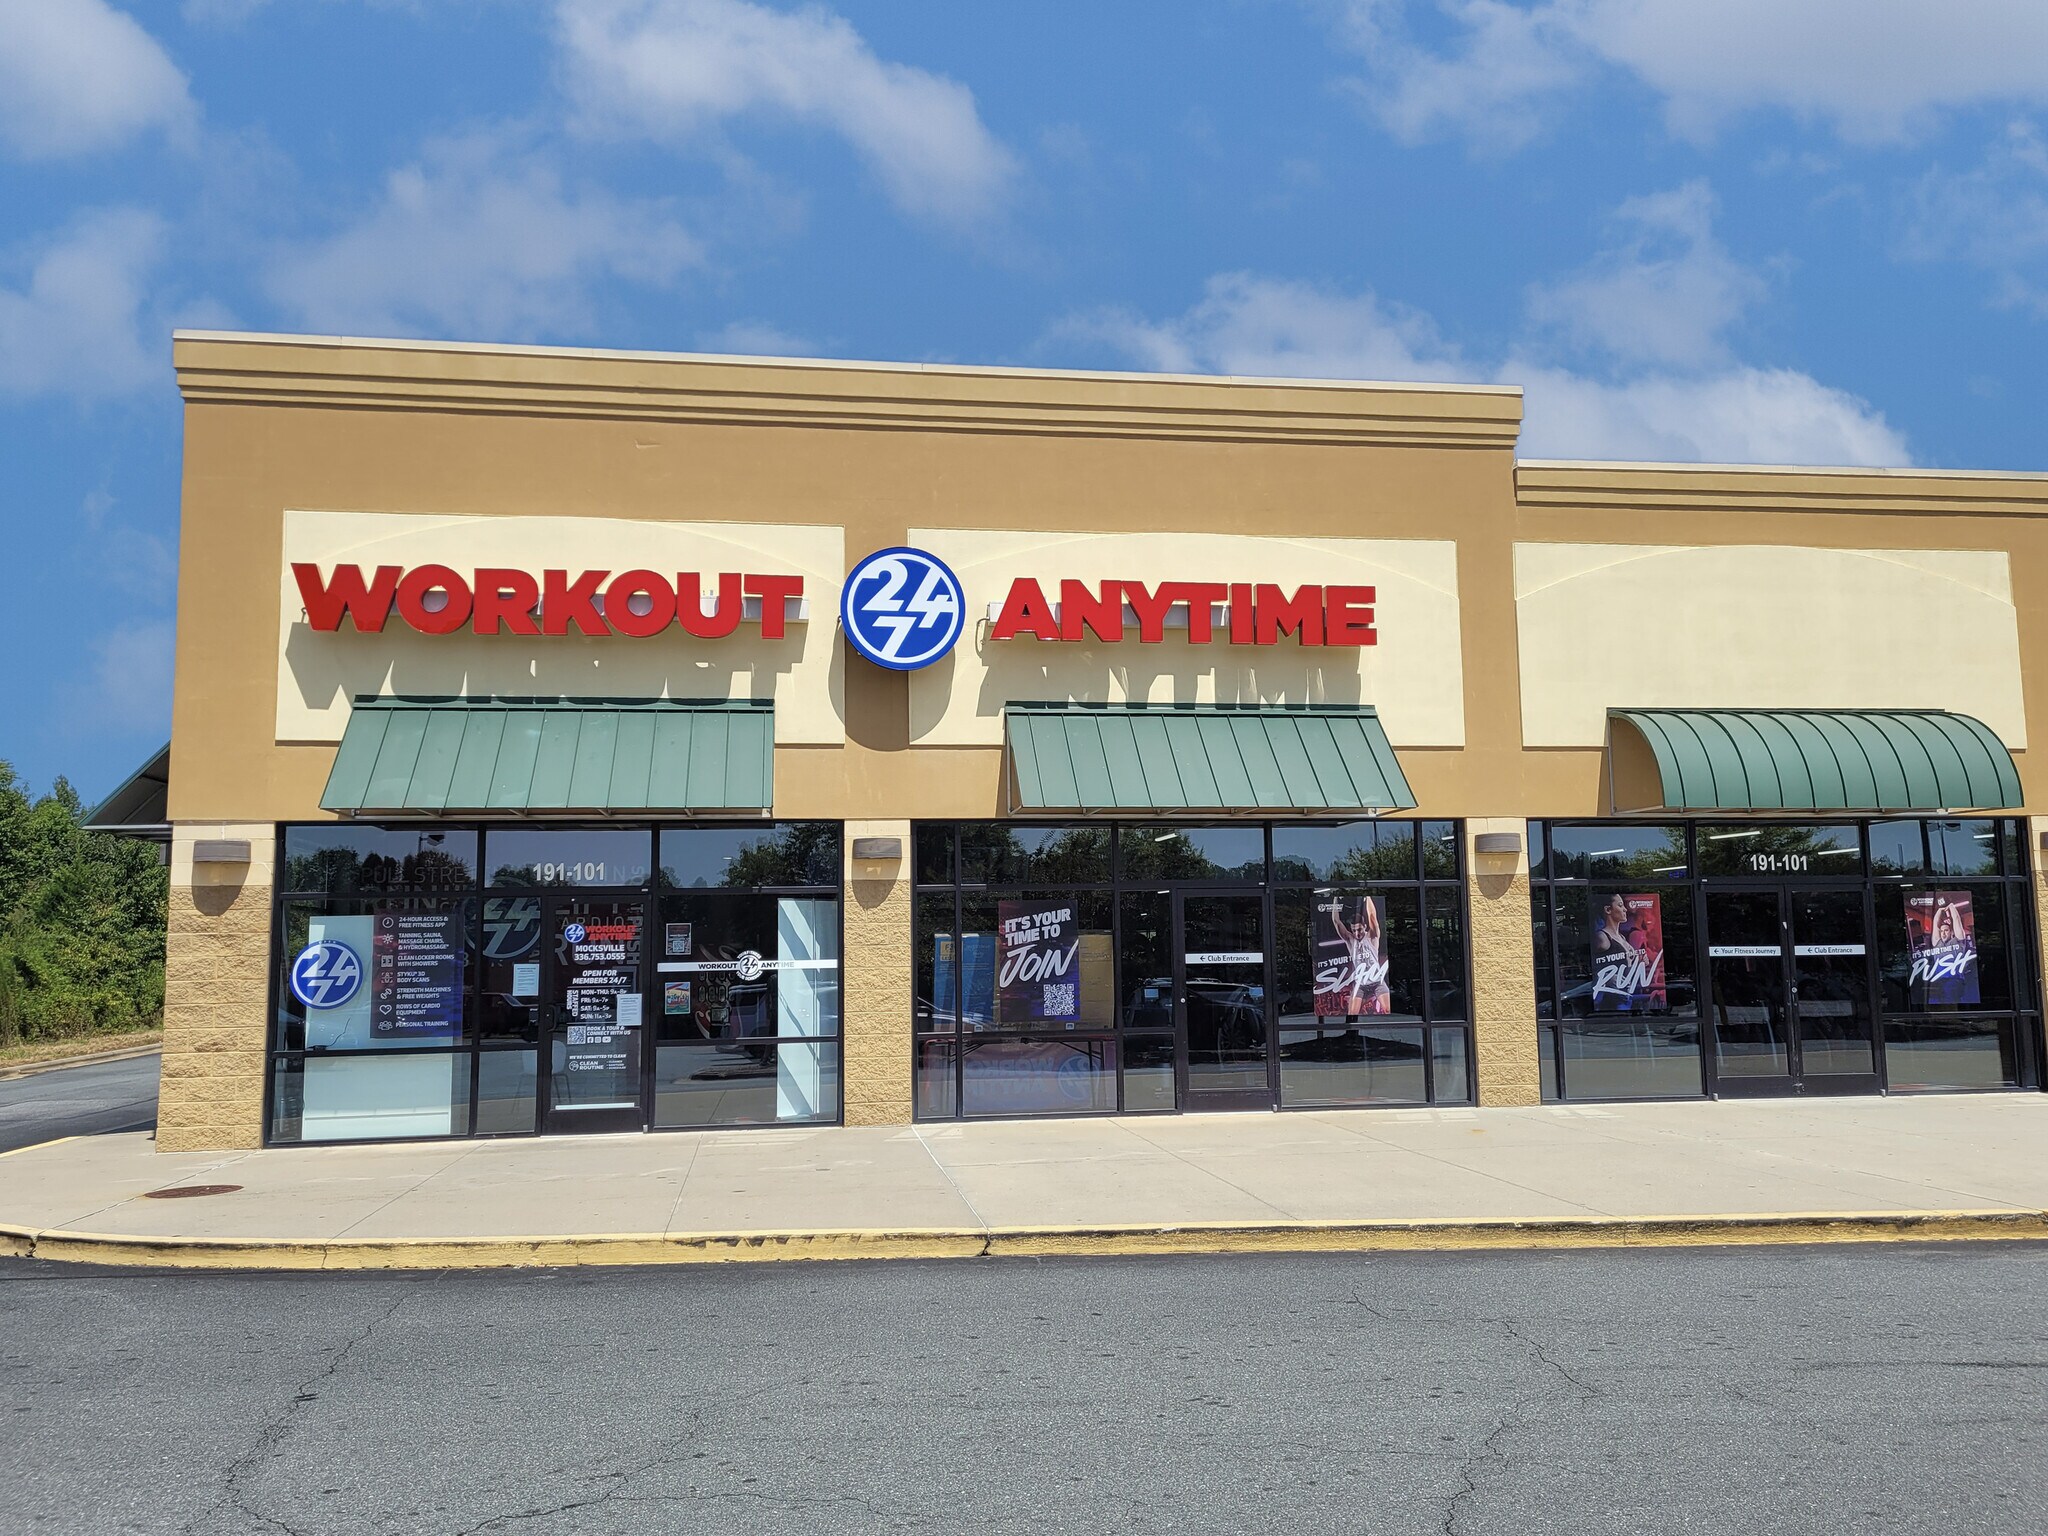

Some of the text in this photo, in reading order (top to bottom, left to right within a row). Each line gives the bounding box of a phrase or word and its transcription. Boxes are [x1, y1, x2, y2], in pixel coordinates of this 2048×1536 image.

[291, 563, 804, 640] WORKOUT
[990, 578, 1378, 646] ANYTIME
[1750, 854, 1808, 871] 191-101
[533, 862, 604, 881] 191-101
[1005, 908, 1071, 933] IT'S YOUR
[585, 925, 637, 933] WORKOUT
[1005, 924, 1061, 946] TIME TO
[588, 933, 636, 941] ANYTIME
[576, 944, 625, 952] MOCKSVILLE
[1755, 947, 1776, 955] Journey
[1922, 947, 1940, 957] YOUR
[1940, 945, 1953, 953] TIME
[574, 953, 625, 961] 336.753.0555
[1000, 938, 1079, 988] JOIN
[1328, 956, 1348, 966] YOUR
[1606, 952, 1625, 963] YOUR
[582, 969, 602, 977] OPEN
[1593, 948, 1664, 1000] RUN
[1909, 949, 1977, 987] PUSH
[572, 976, 627, 985] MEMBERS 24/7
[1313, 959, 1389, 1000] SLAM
